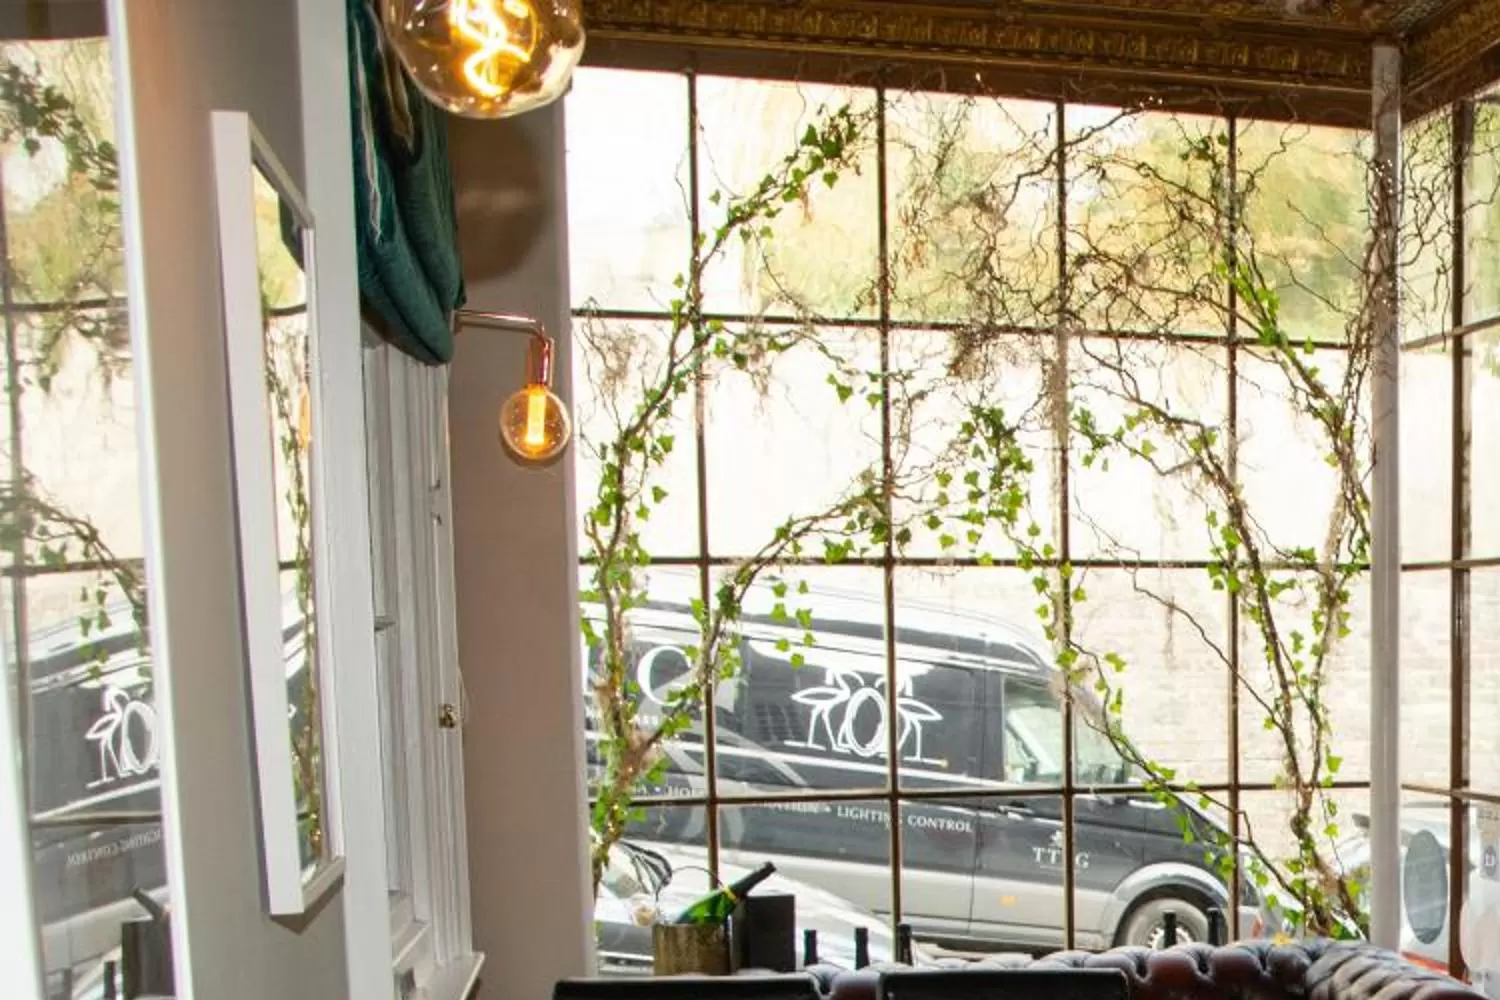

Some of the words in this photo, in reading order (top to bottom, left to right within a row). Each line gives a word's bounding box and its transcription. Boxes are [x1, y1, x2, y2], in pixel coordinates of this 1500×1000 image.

[837, 805, 902, 826] LIGHTIN
[907, 815, 973, 832] CONTROL
[1032, 847, 1089, 869] TTG
